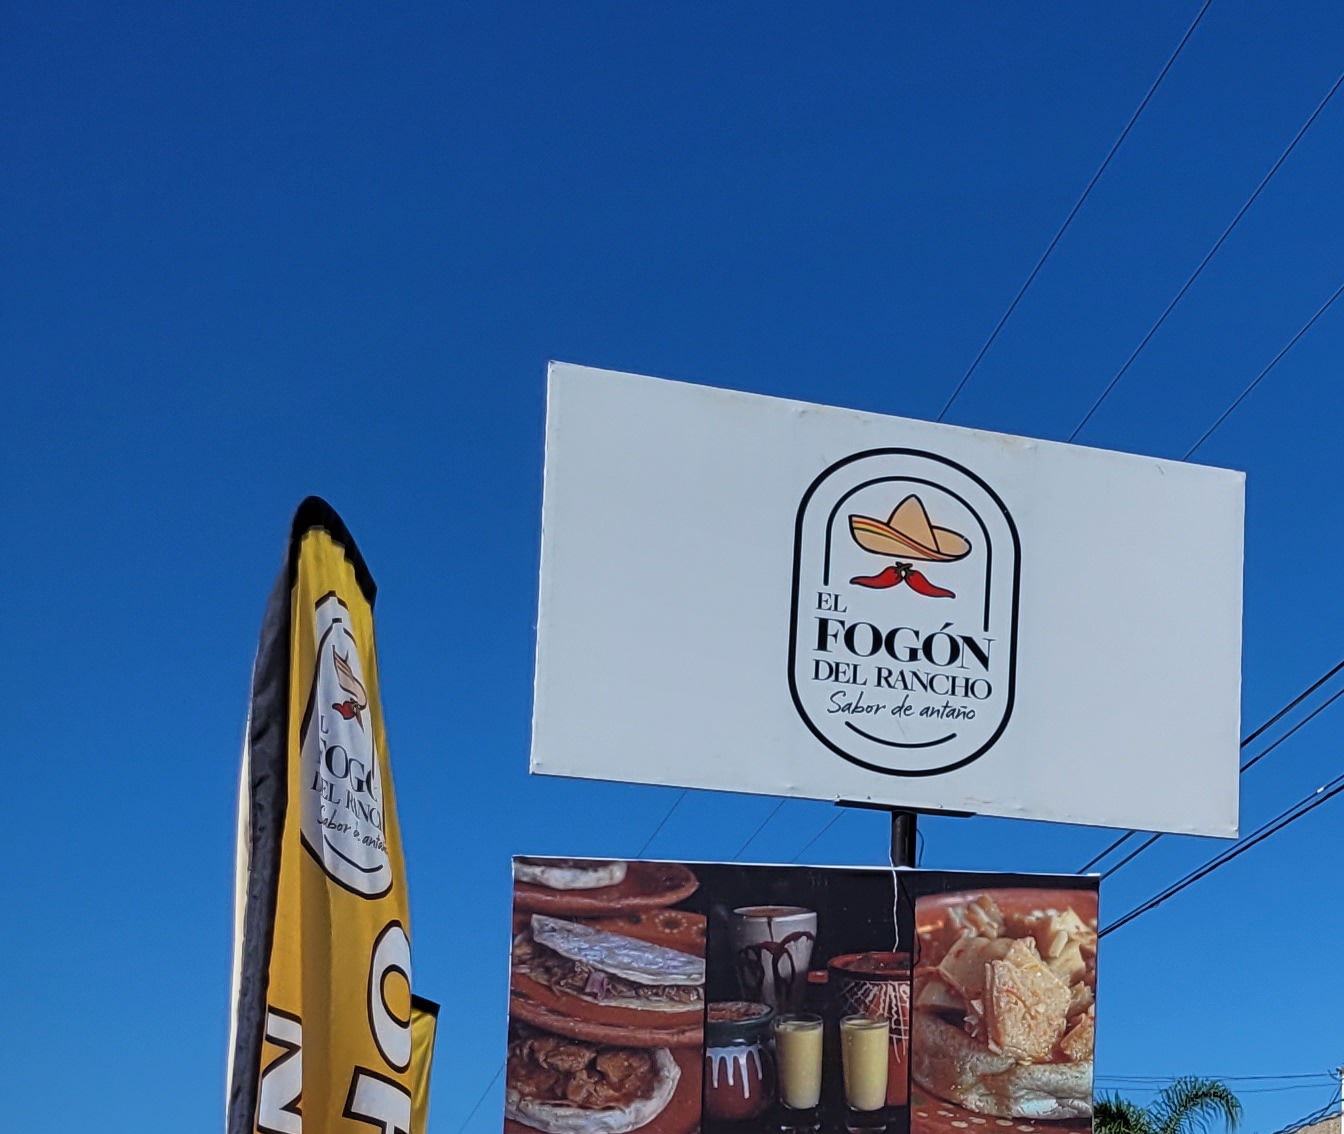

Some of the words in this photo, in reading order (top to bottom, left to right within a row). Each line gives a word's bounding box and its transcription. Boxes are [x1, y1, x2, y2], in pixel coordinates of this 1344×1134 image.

[816, 591, 848, 613] EL
[812, 616, 996, 672] FOGÓN
[812, 658, 868, 686] DEL
[874, 666, 993, 701] RANCHO
[827, 690, 887, 715] Sabor
[890, 694, 915, 718] de
[919, 700, 976, 720] antaño
